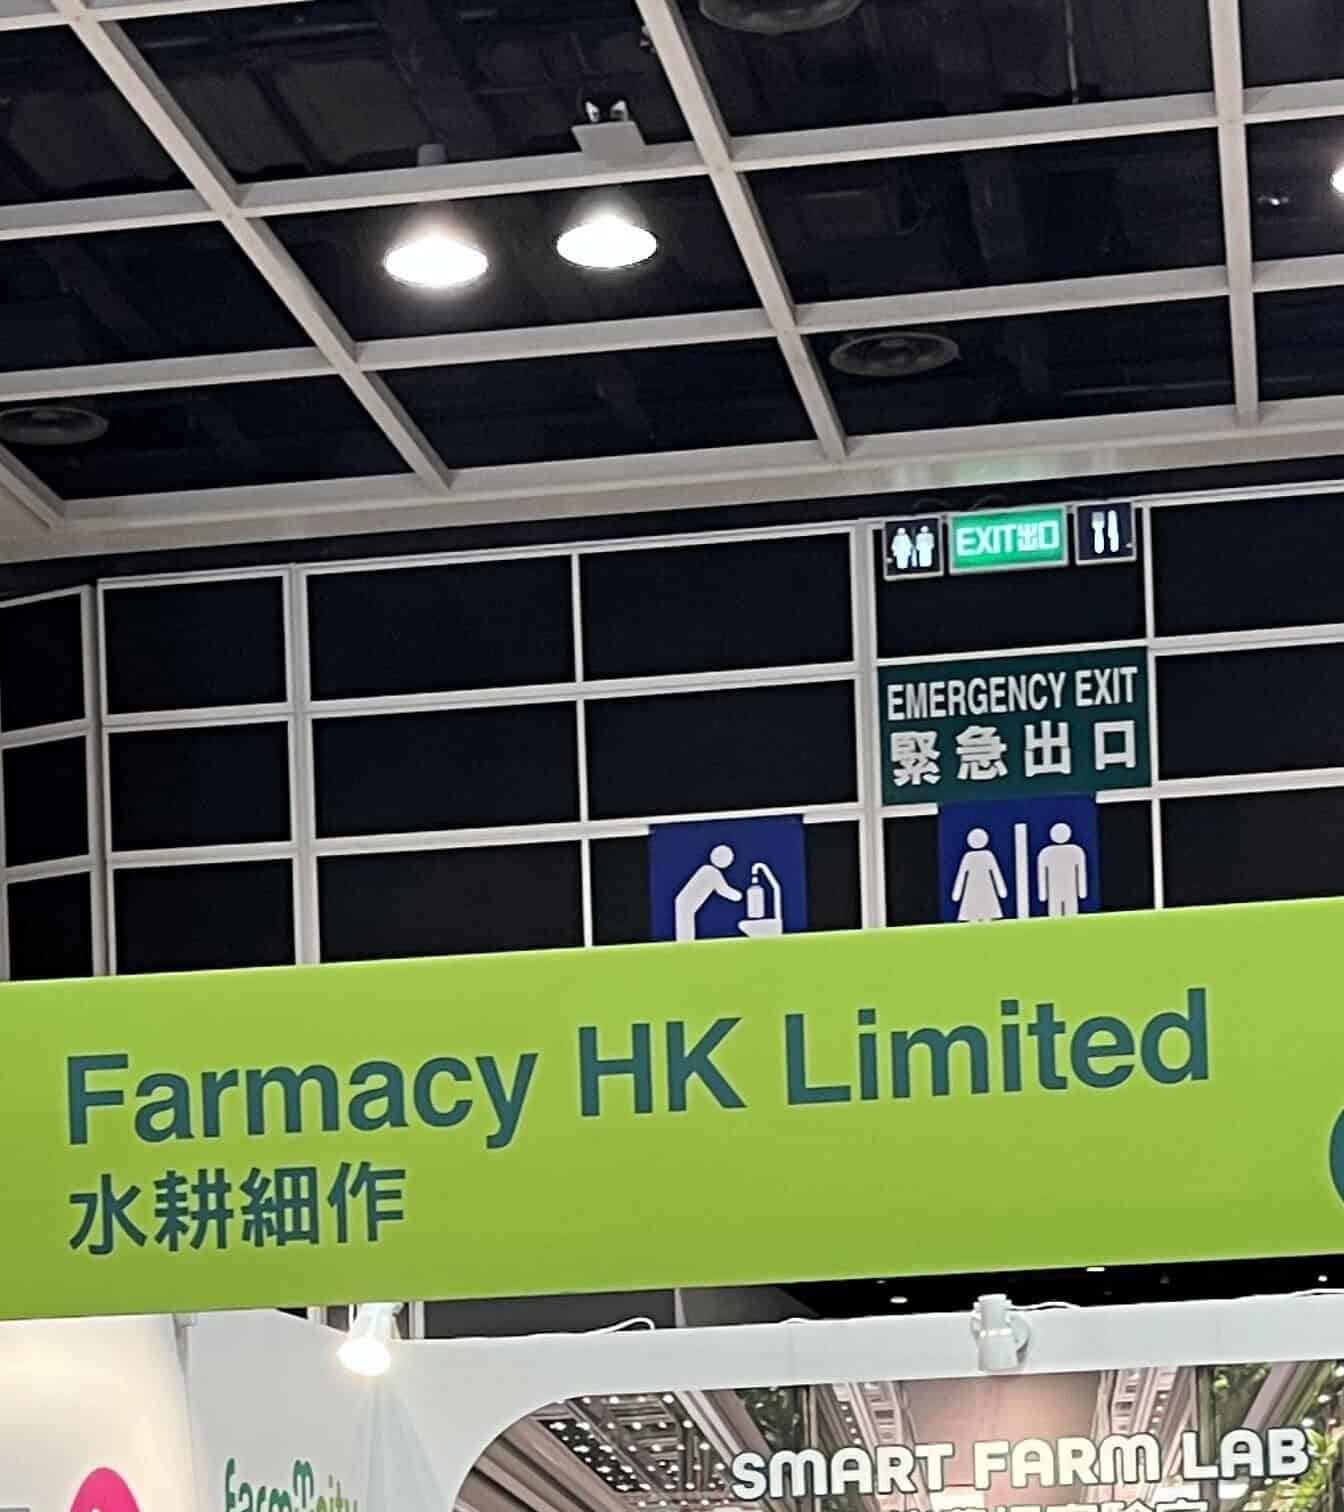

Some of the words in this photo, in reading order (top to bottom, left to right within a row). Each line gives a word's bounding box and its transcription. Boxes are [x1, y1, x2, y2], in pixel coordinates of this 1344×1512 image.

[956, 522, 1017, 556] EXIT
[887, 671, 1067, 720] EMERGENCY
[1075, 666, 1138, 707] EXIT
[889, 719, 1137, 786] 緊急出口
[65, 1047, 539, 1150] Farmacy
[576, 1016, 747, 1118] HK
[783, 986, 1211, 1106] Limited
[67, 1159, 408, 1257] 水耕細作
[731, 1443, 952, 1500] SMART
[973, 1434, 1162, 1490] FARM
[1181, 1427, 1311, 1481] LAB
